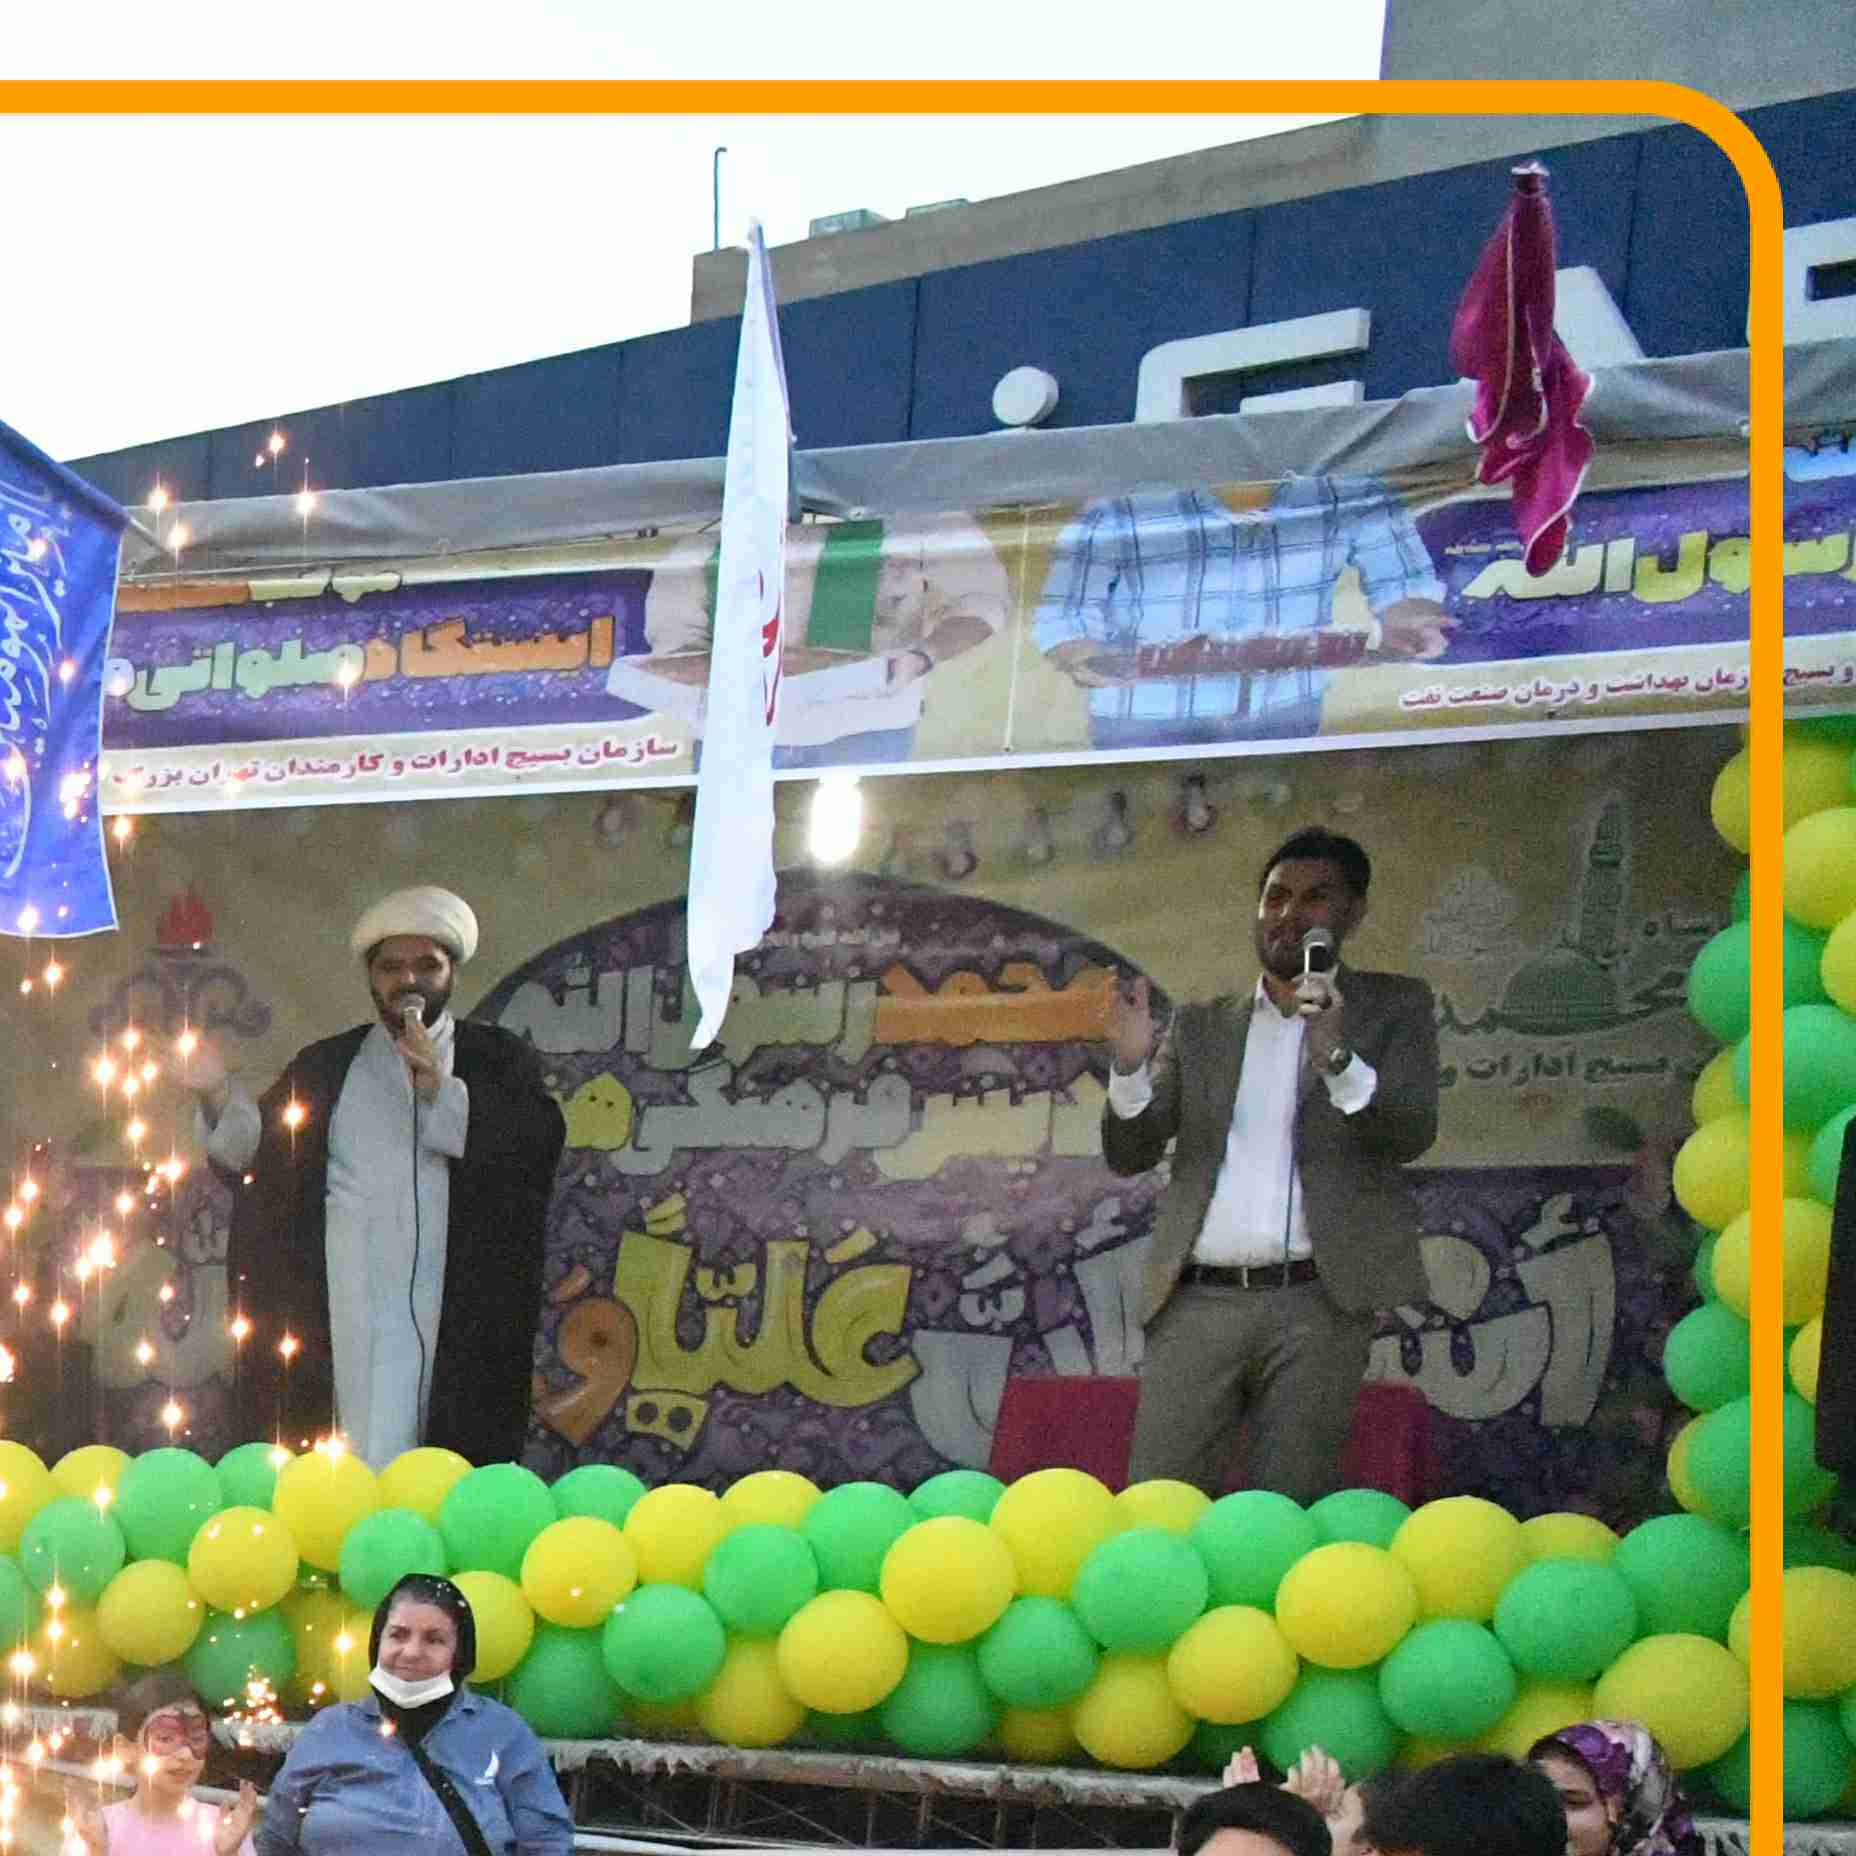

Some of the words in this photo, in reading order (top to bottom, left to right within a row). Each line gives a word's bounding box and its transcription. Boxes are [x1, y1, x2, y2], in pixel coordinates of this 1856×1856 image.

[366, 615, 615, 681] ایستگاه
[126, 639, 365, 711] صلواتی
[411, 747, 500, 773] ادارات
[505, 748, 572, 770] بسیج
[577, 737, 678, 766] سازمان
[264, 752, 384, 783] کارمندان
[392, 758, 405, 777] و
